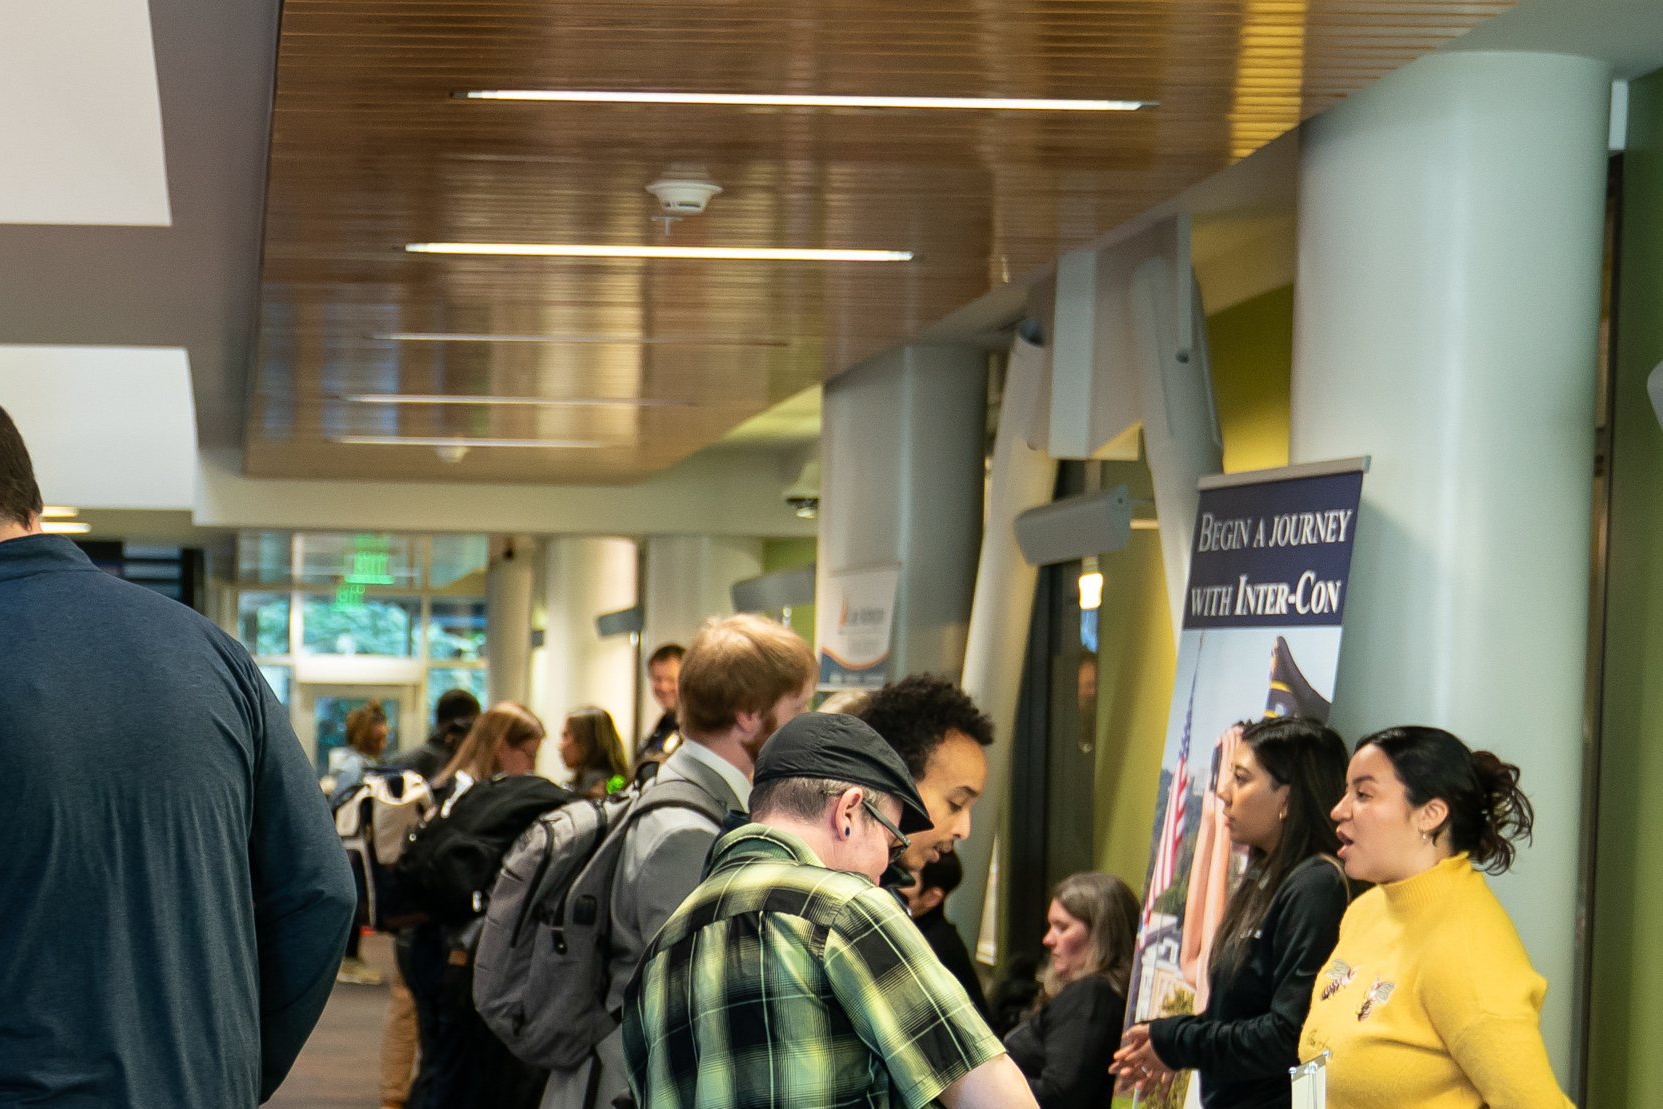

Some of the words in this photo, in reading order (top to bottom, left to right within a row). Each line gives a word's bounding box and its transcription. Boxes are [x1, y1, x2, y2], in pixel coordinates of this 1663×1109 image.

[1199, 512, 1252, 553] BEGIN
[1253, 517, 1266, 549] A
[1269, 509, 1352, 547] JOURNEY
[1192, 586, 1233, 616] WITH
[1235, 570, 1342, 616] INTER-CON
